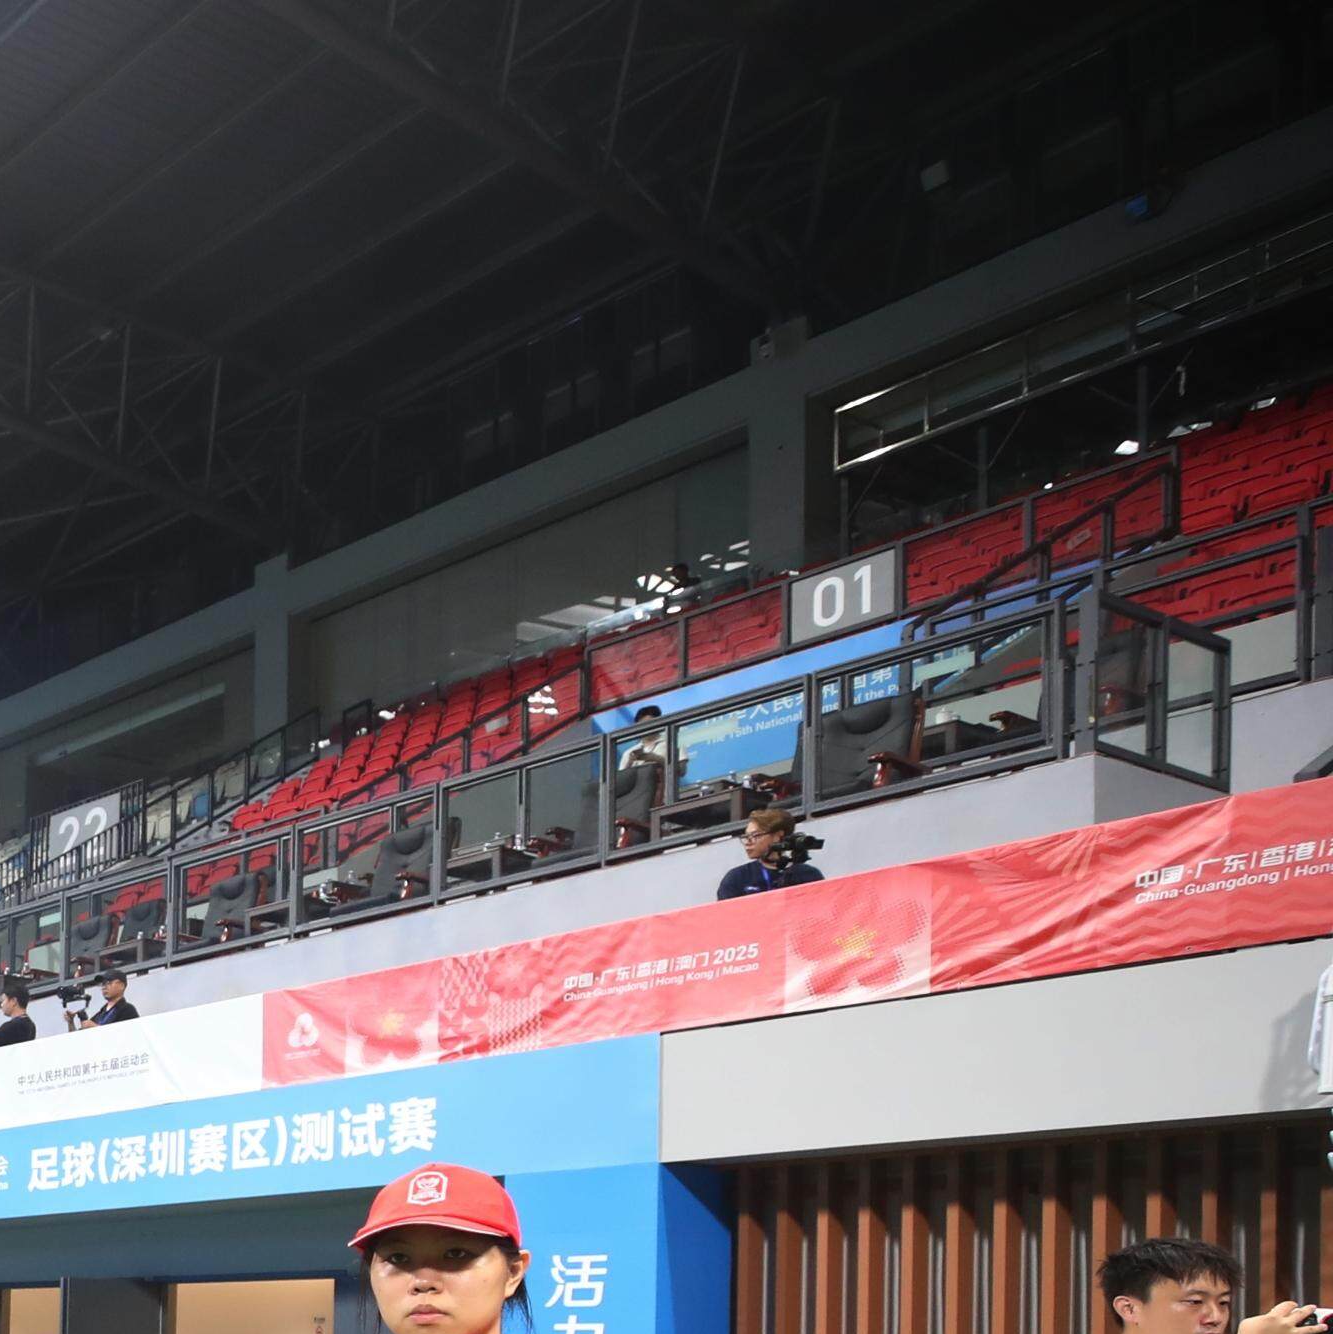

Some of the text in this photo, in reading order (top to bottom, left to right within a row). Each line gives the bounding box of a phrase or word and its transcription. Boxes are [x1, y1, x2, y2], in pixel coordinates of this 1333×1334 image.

[813, 564, 871, 628] 01
[865, 688, 885, 700] the
[756, 710, 803, 732] National
[59, 806, 108, 869] 22
[713, 943, 759, 966] 2025
[655, 973, 684, 988] Hong
[686, 969, 714, 982] Kong
[722, 962, 759, 976] Macao
[17, 1052, 149, 1087] 中华人民共和国第十五届运动会
[27, 1096, 438, 1192] 足球(深圳赛区)测试赛
